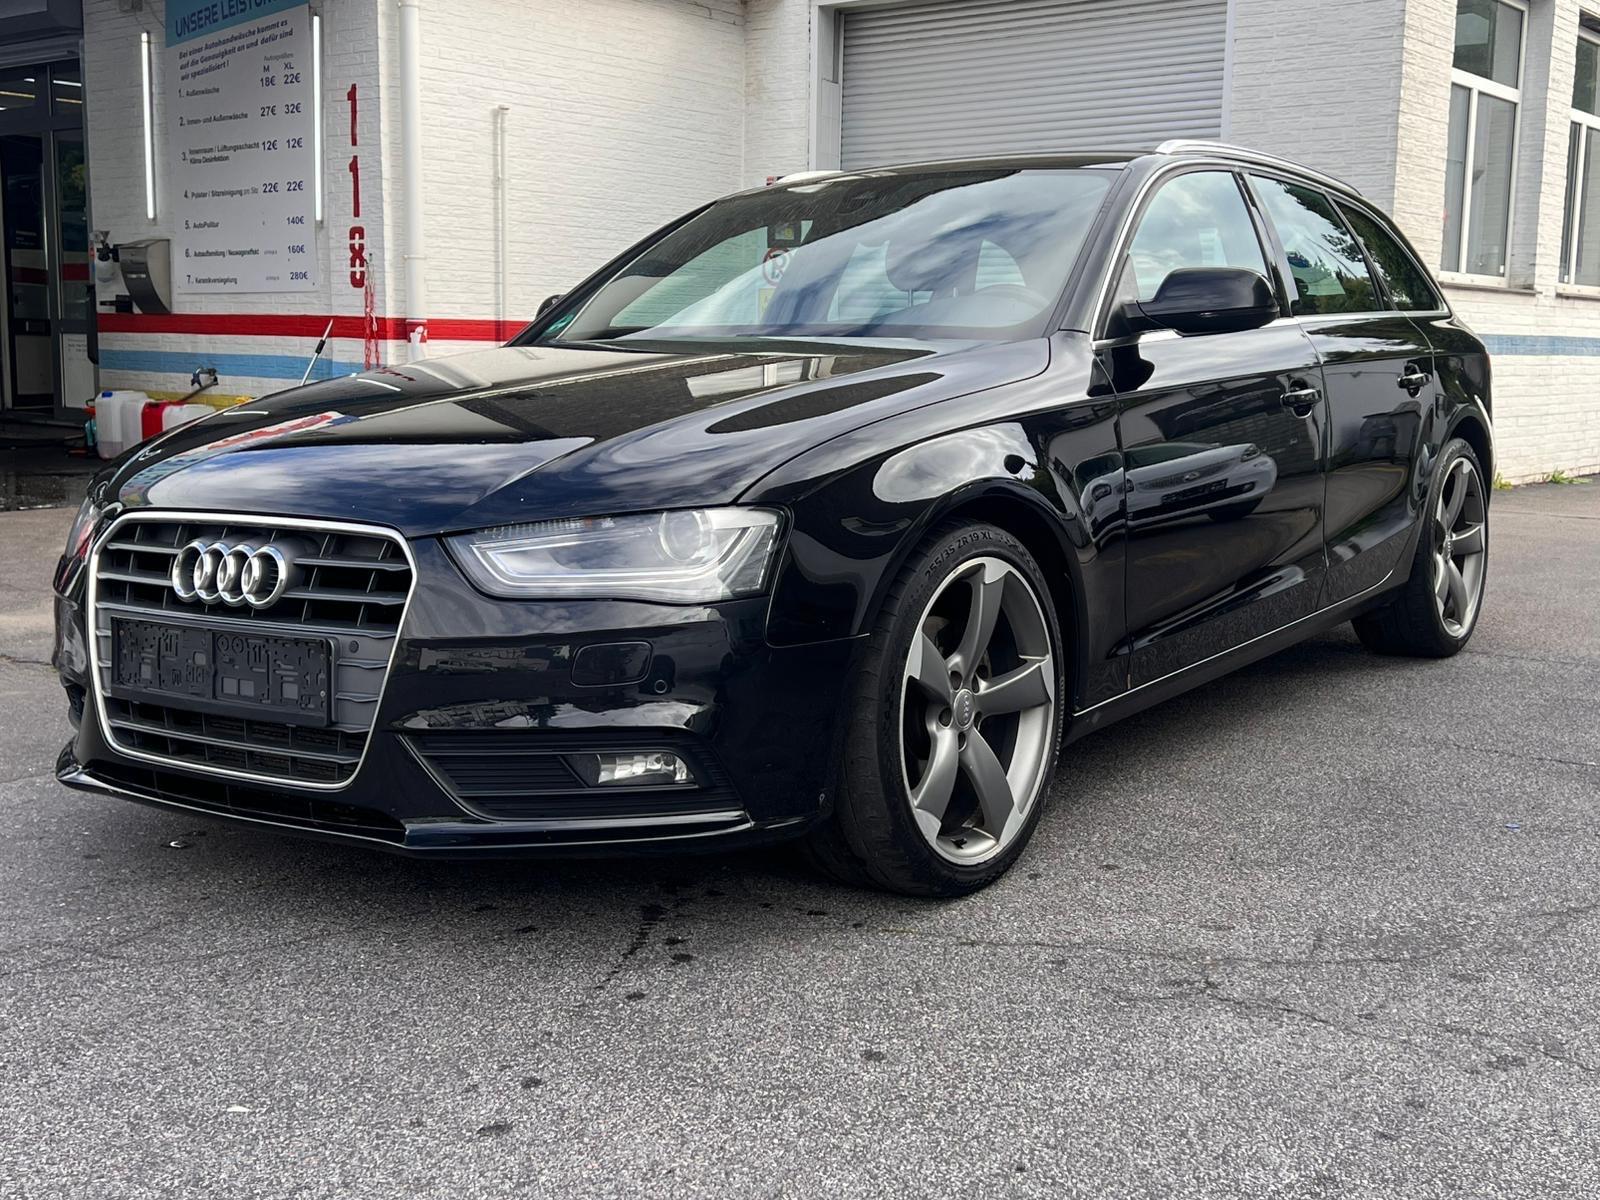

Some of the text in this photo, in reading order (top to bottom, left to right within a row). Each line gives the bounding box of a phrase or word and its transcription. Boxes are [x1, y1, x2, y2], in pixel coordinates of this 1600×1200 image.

[175, 3, 219, 38] UNSERE
[189, 46, 204, 57] einer
[204, 30, 256, 50] Autohandwäsche
[257, 21, 280, 35] kommt
[280, 20, 288, 28] es
[180, 27, 294, 70] auf die Genauigkeit an und dafür sind
[181, 73, 189, 81] wir
[191, 62, 226, 80] spezialisiert
[263, 62, 295, 73] M XL
[178, 88, 185, 98] 1.
[260, 76, 276, 88] 18€
[284, 73, 301, 85] 22€
[179, 117, 186, 127] 2.
[261, 105, 277, 117] 27€
[285, 103, 302, 114] 32€
[262, 140, 278, 151] 12€
[287, 138, 303, 149] 12€
[181, 152, 189, 161] 3.
[184, 190, 189, 199] 4.
[263, 182, 279, 193] 22€
[287, 180, 304, 192] 22€
[185, 220, 191, 230] 5.
[286, 216, 305, 225] 140€
[185, 248, 192, 258] 6.
[288, 245, 306, 254] 160€
[186, 275, 194, 284] 7.
[290, 271, 309, 280] 280€
[925, 546, 956, 578] 255/35
[956, 537, 969, 550] ZR
[969, 532, 980, 543] 19
